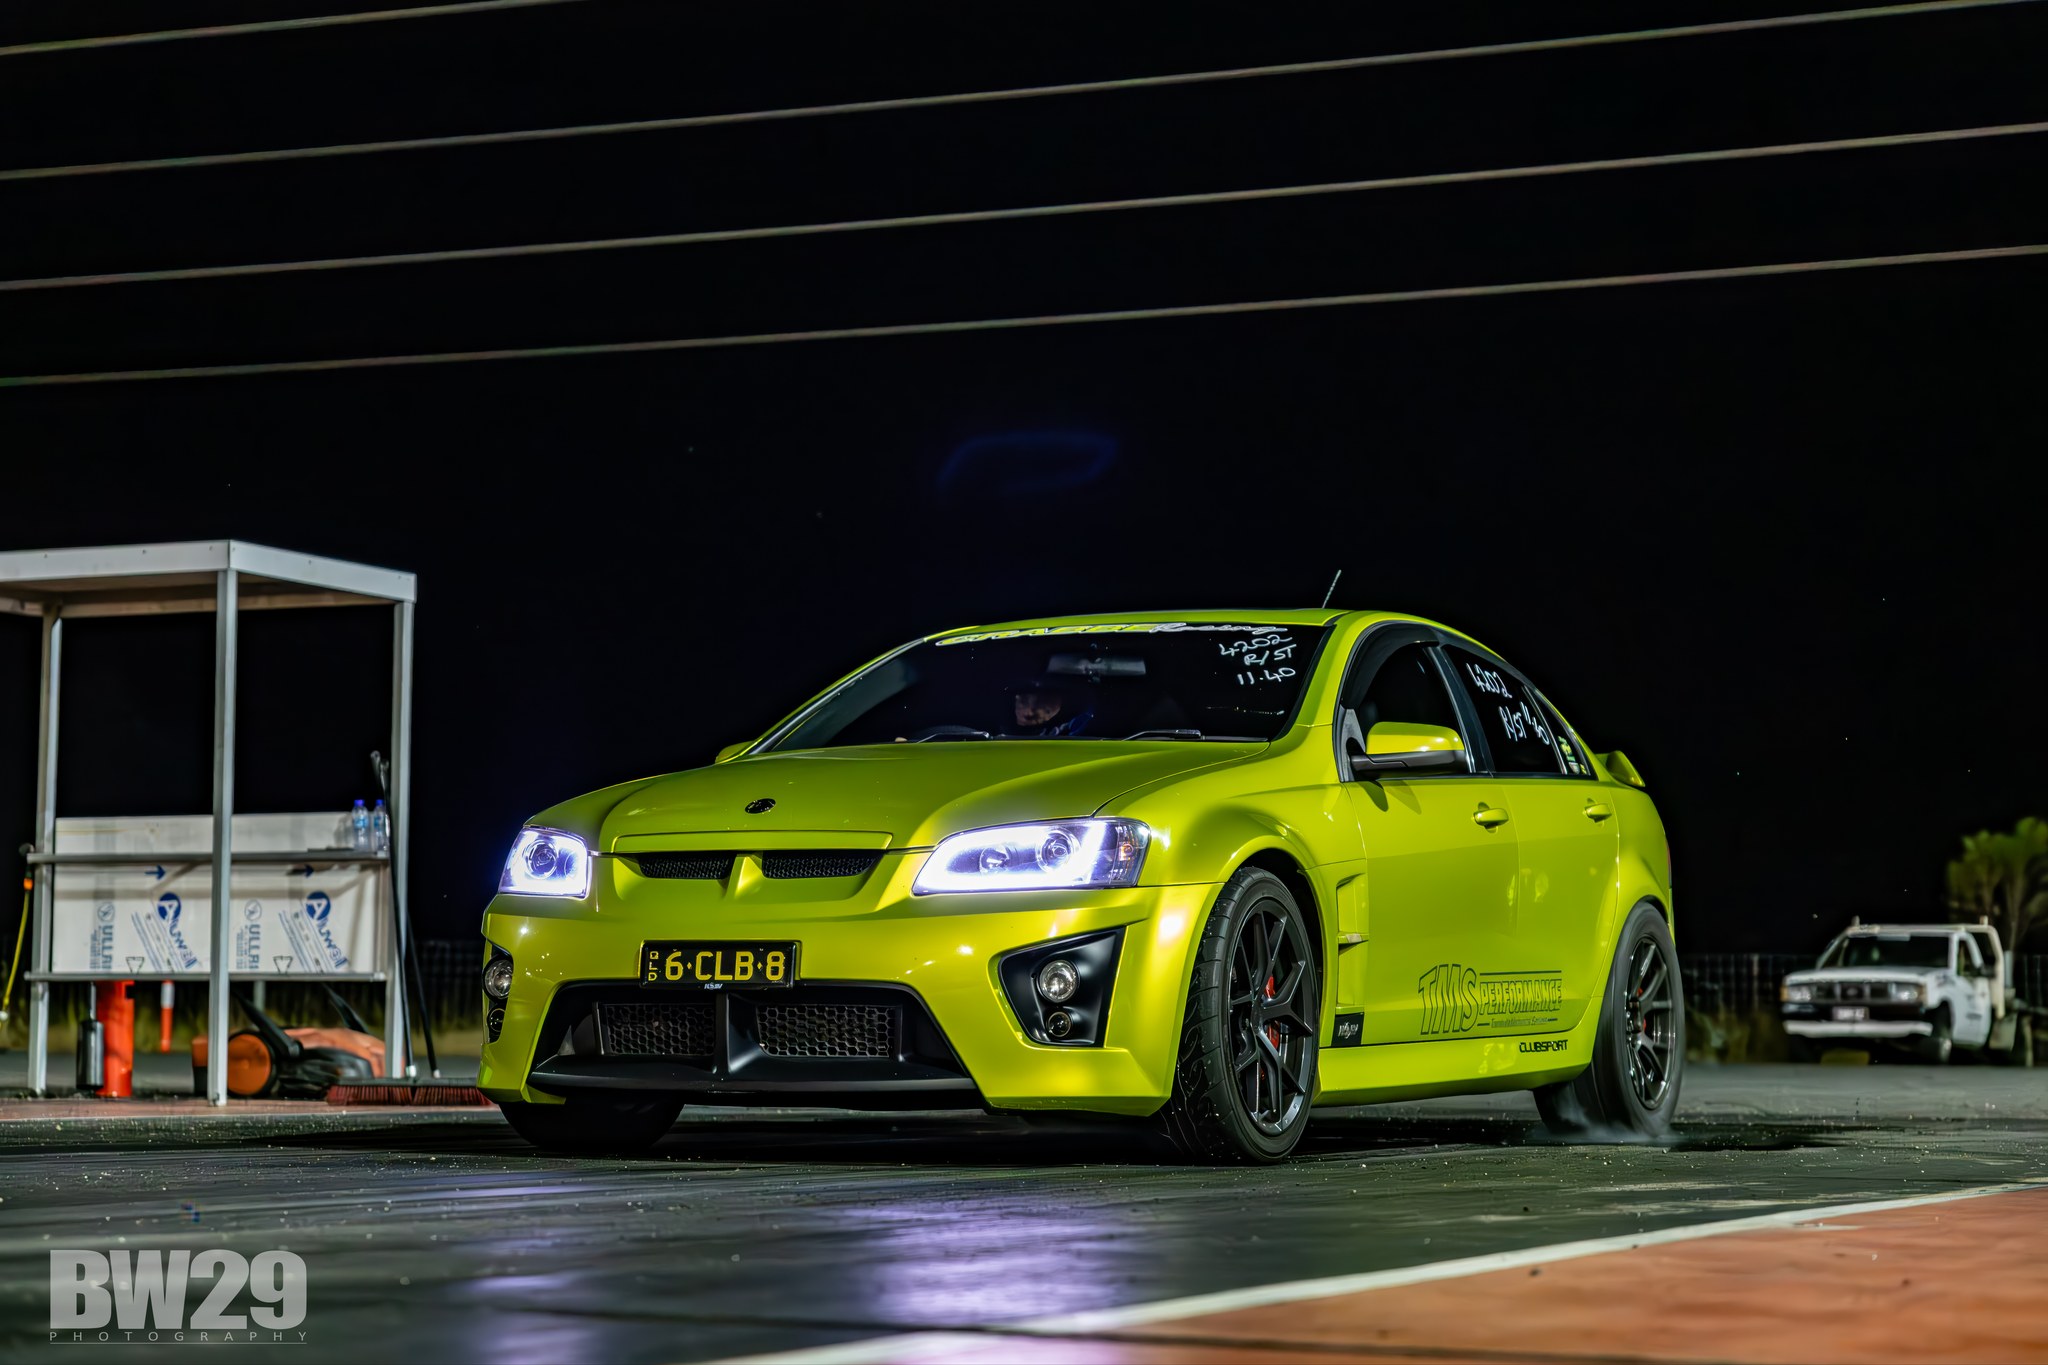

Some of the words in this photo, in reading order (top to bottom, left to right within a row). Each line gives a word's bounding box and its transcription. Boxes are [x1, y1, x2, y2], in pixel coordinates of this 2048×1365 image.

[1219, 634, 1293, 657] 4202
[1237, 667, 1296, 686] 11.40
[648, 950, 660, 982] QLD
[1418, 963, 1479, 1035] TMS
[1479, 978, 1563, 1016] PERFORMANCE
[1519, 1039, 1568, 1053] CLUBSPORT
